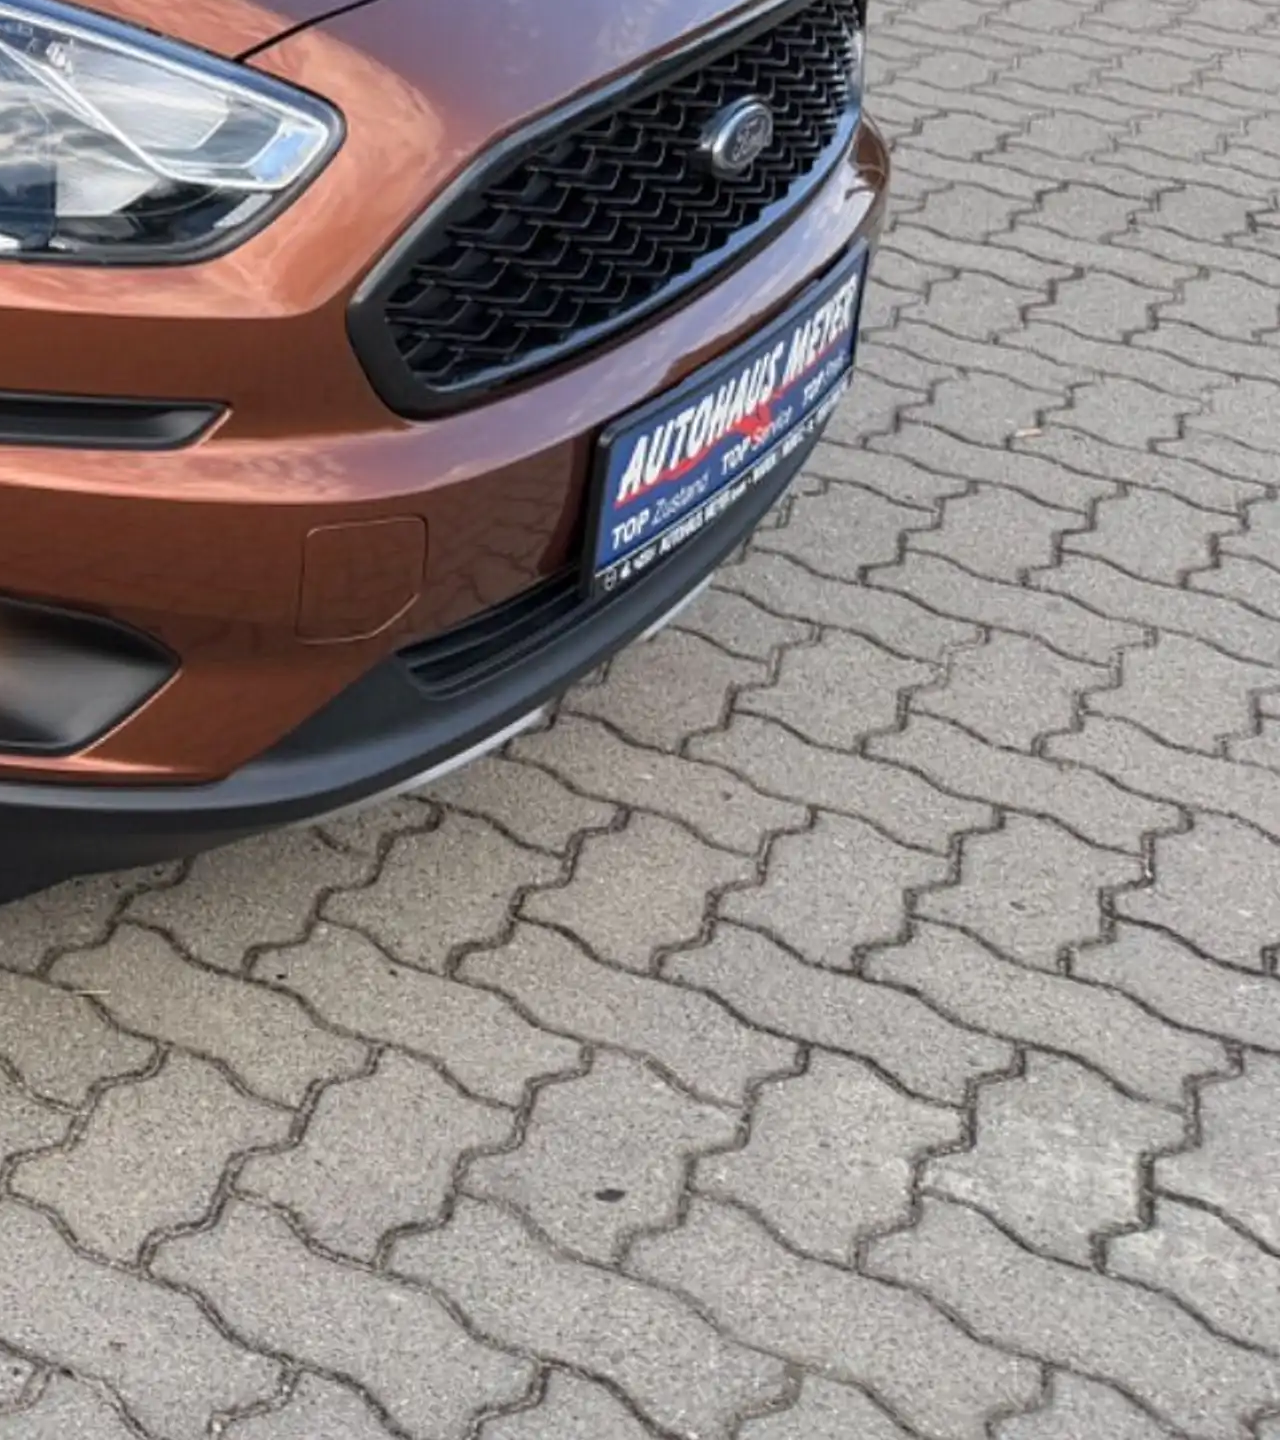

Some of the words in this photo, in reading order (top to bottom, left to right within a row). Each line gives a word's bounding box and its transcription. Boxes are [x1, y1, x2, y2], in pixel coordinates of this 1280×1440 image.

[616, 342, 785, 501] AUTOHAUS
[612, 509, 650, 550] TOP
[651, 469, 711, 525] Zustand
[721, 436, 750, 475] TOP
